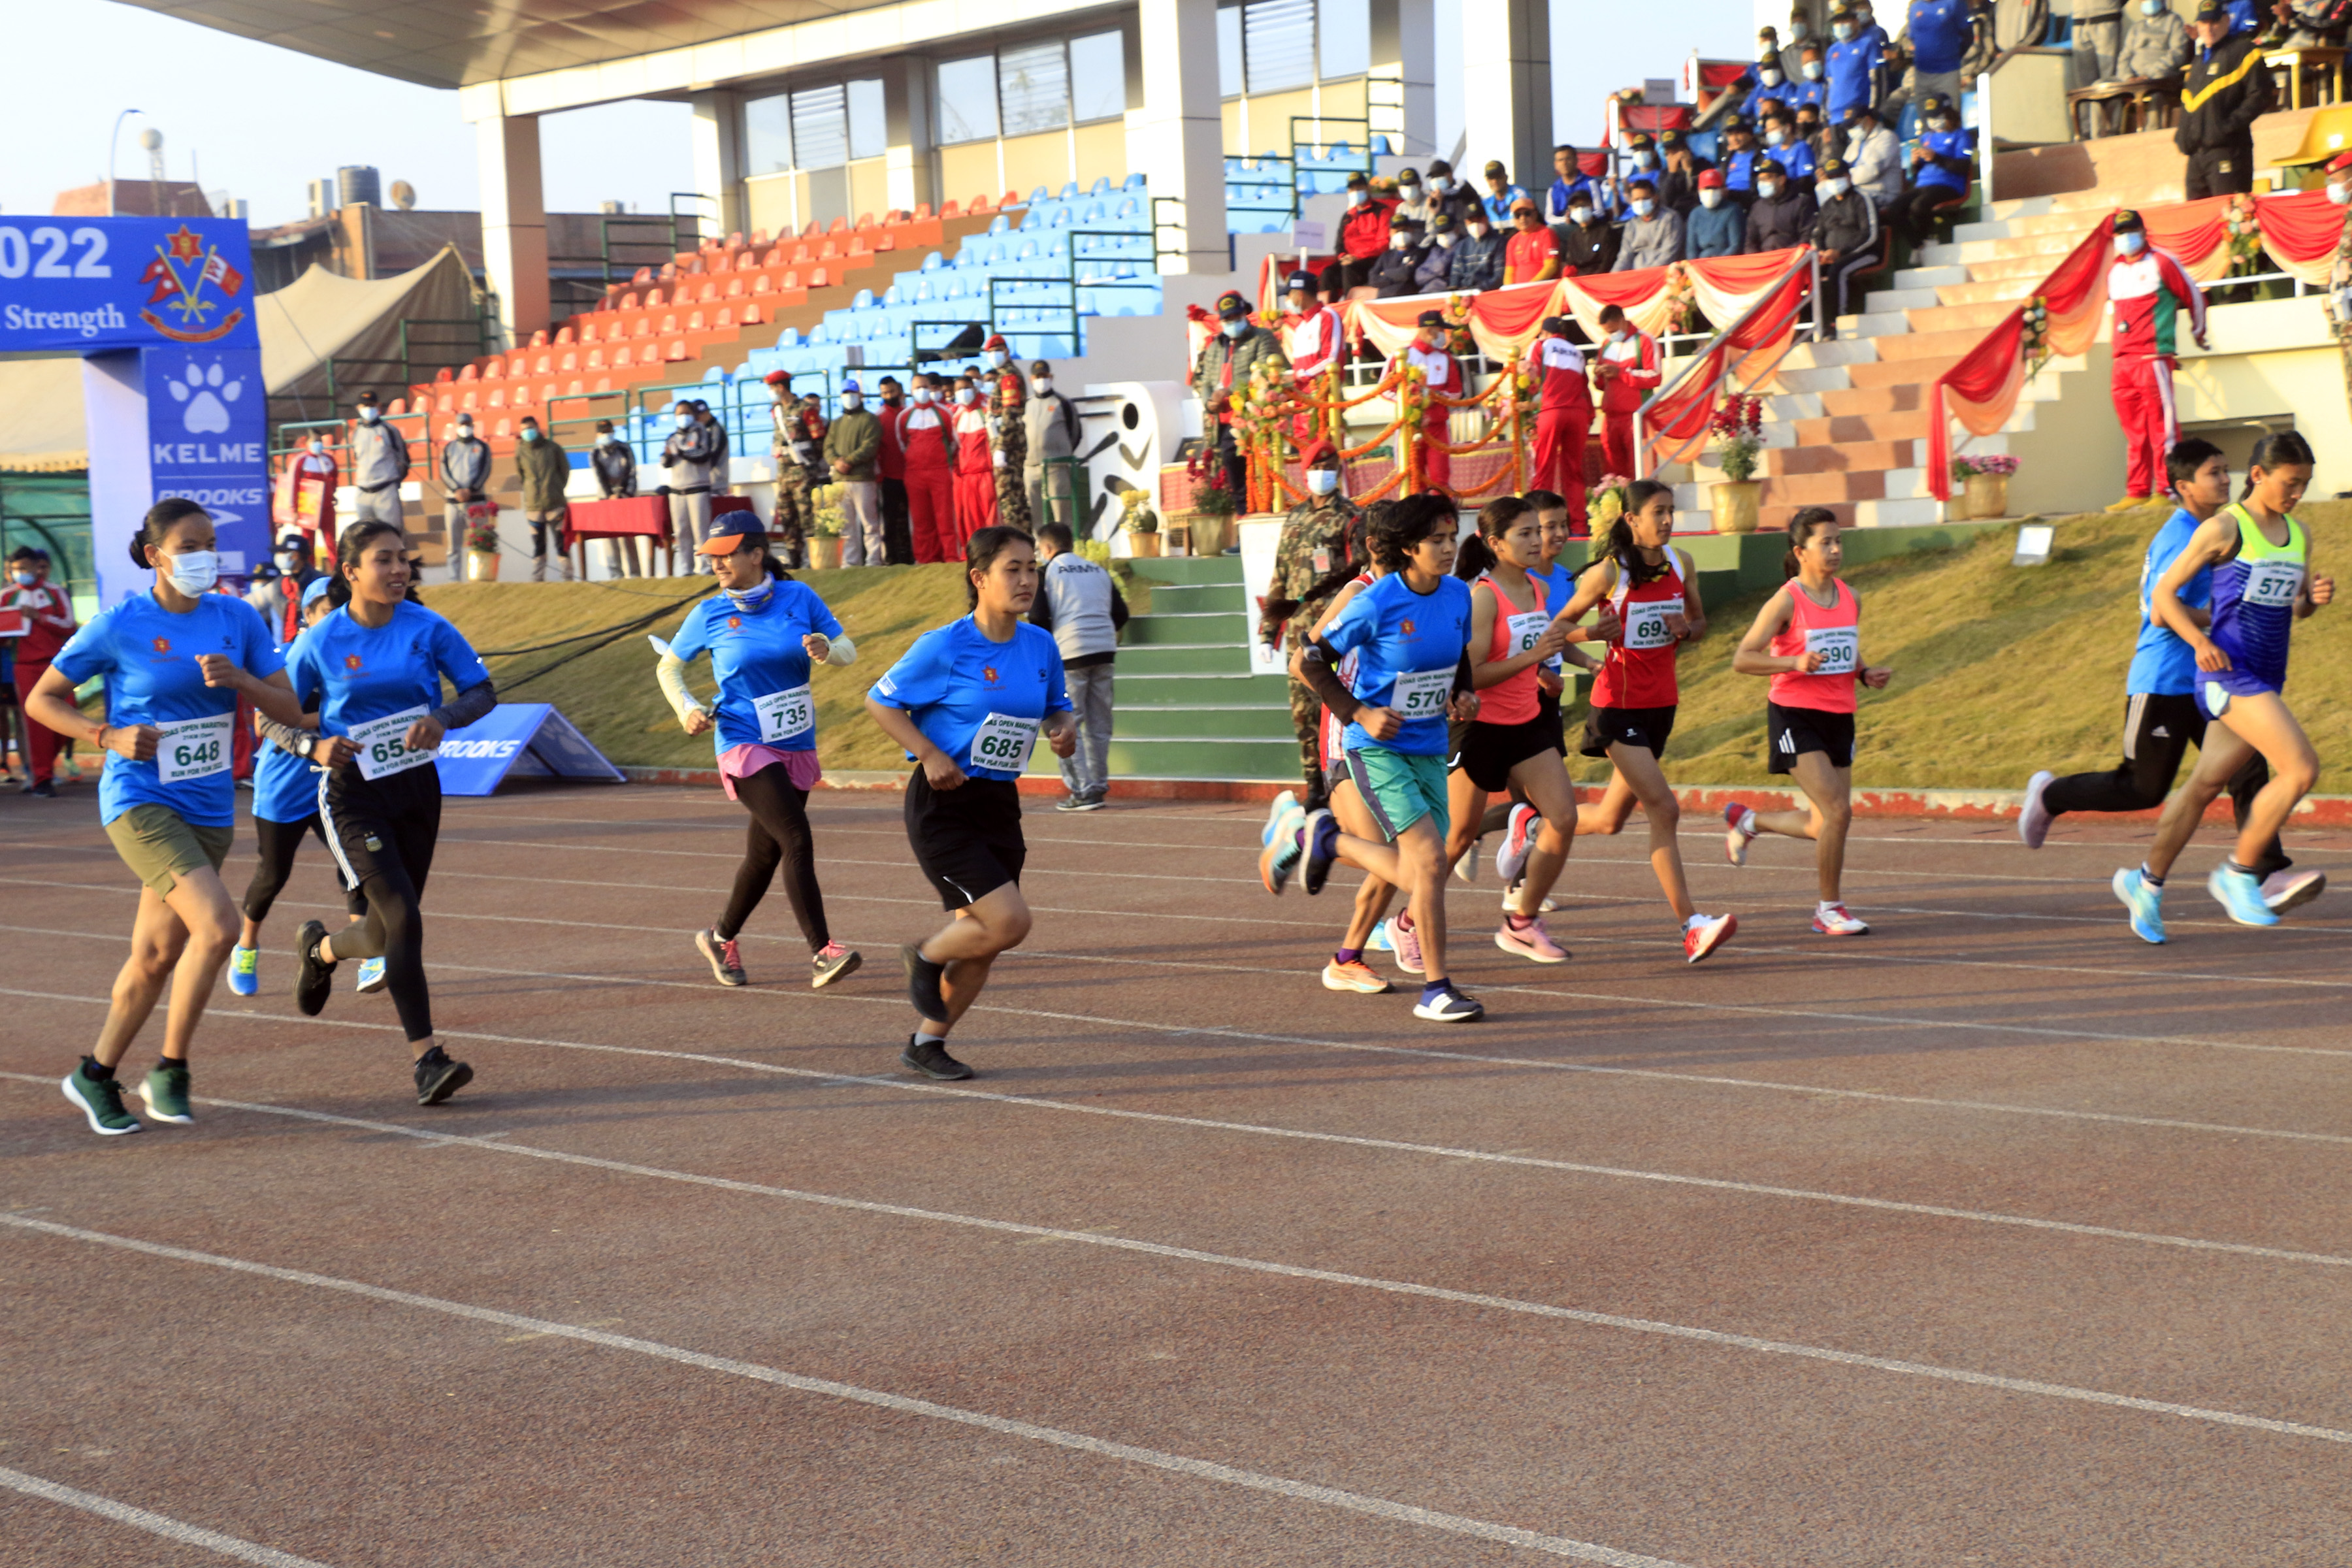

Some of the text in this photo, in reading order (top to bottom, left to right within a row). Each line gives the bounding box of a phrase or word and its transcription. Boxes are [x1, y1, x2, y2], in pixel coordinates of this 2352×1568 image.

[5, 303, 126, 337] Strength
[154, 443, 261, 463] KELME
[1058, 564, 1100, 574] ARMY
[2258, 578, 2296, 597] 572
[1405, 688, 1446, 709] 570
[772, 704, 806, 728] 735
[998, 719, 1014, 728] OPEN
[180, 723, 199, 733] OPEN
[353, 728, 372, 741] COAS
[372, 721, 390, 732] OPEN
[174, 740, 220, 767] 648
[438, 740, 521, 758] ROOKS
[981, 735, 1024, 759] 685
[371, 765, 385, 775] RUN
[386, 761, 399, 770] FOR
[400, 757, 413, 766] FUN
[973, 755, 985, 764] RUN
